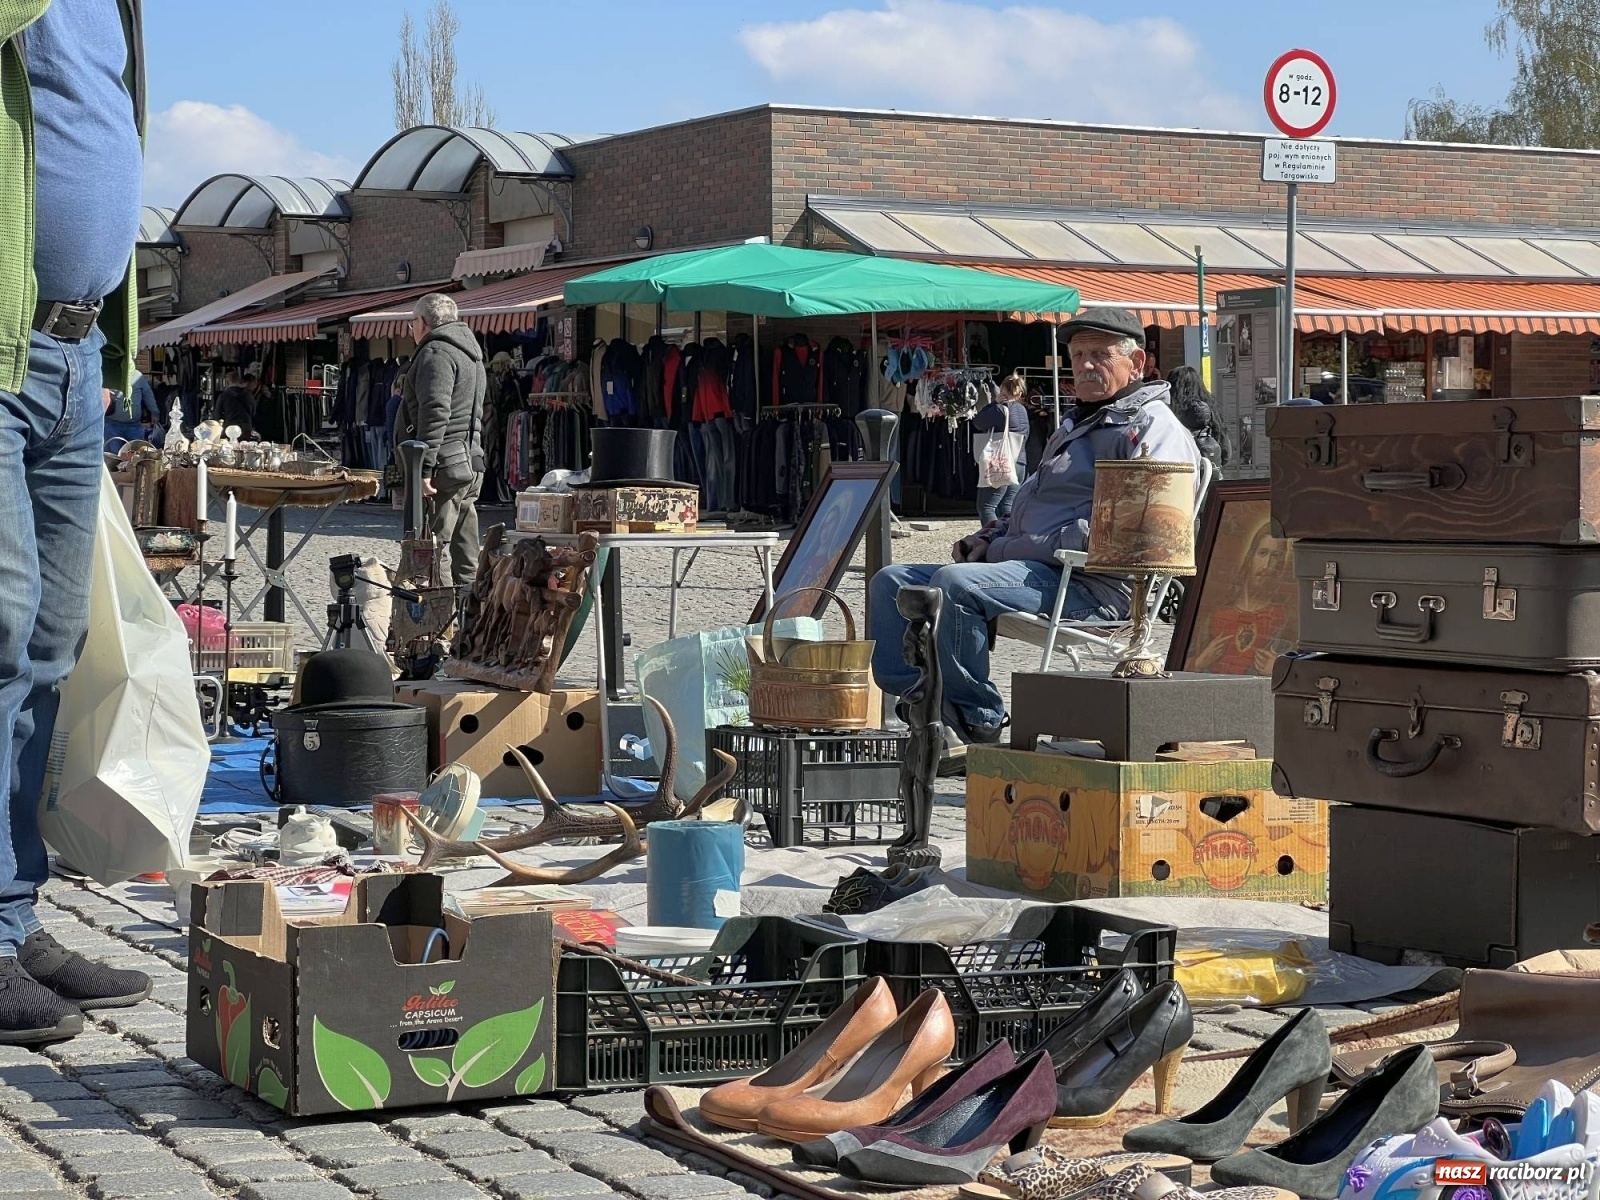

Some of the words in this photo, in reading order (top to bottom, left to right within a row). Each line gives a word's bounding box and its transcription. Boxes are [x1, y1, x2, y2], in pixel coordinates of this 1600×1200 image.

[1296, 73, 1314, 82] godz.
[1278, 83, 1322, 106] 8-12
[1280, 142, 1293, 151] Nie
[1295, 143, 1320, 153] dotyczy
[1282, 162, 1326, 171] Regulaminie
[1280, 172, 1319, 181] Targowiska
[402, 995, 459, 1011] Galilee
[405, 1008, 456, 1020] CAPSICUM
